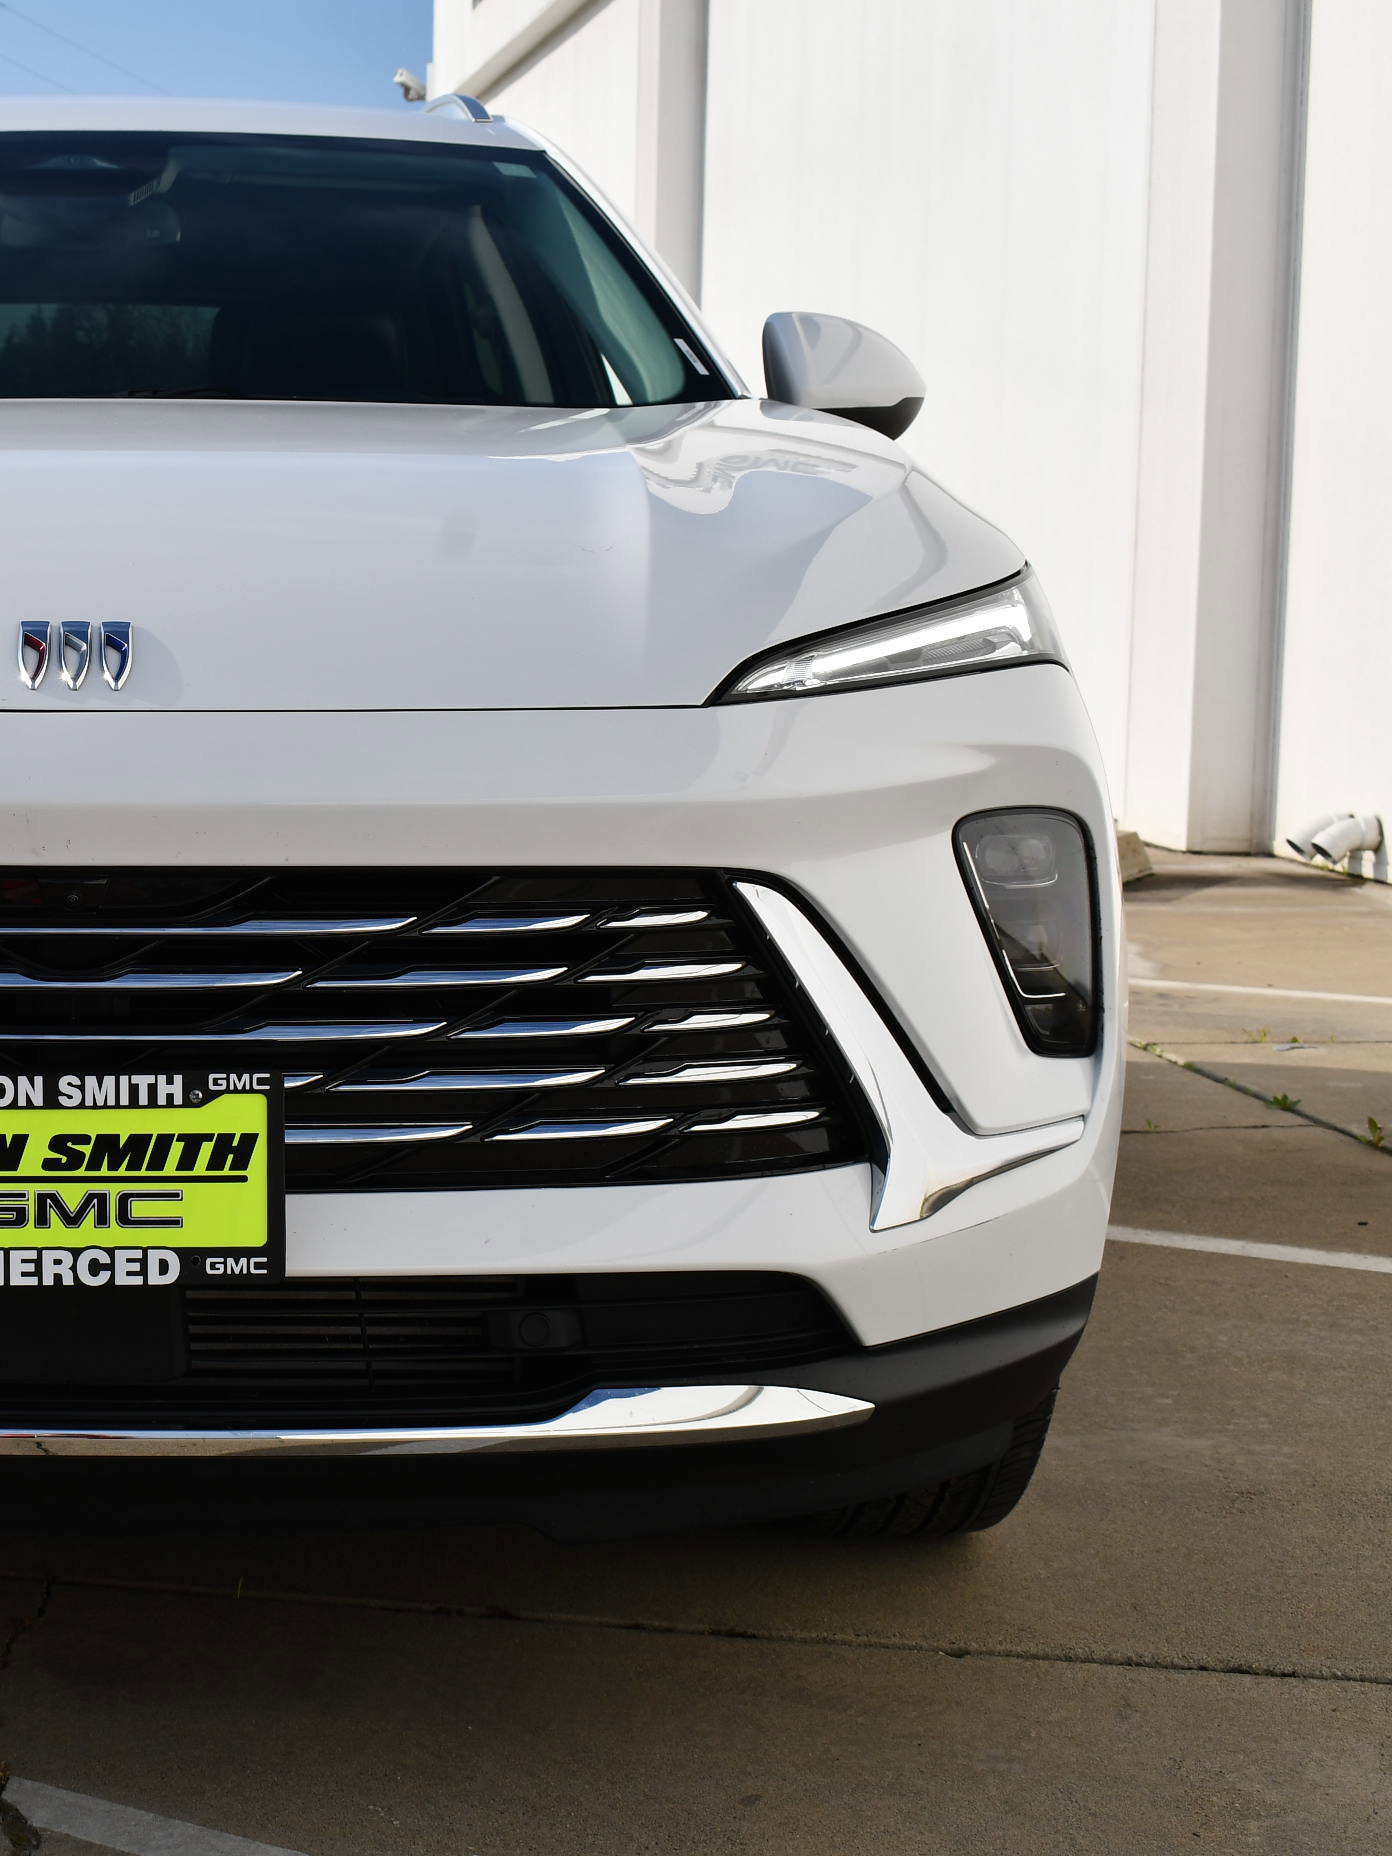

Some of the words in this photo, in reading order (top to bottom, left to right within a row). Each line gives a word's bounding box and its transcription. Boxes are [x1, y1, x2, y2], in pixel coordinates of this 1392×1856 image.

[58, 1074, 183, 1107] SMITH
[208, 1073, 271, 1091] GMC
[41, 1132, 260, 1172] SMITH
[205, 1257, 268, 1275] GMC
